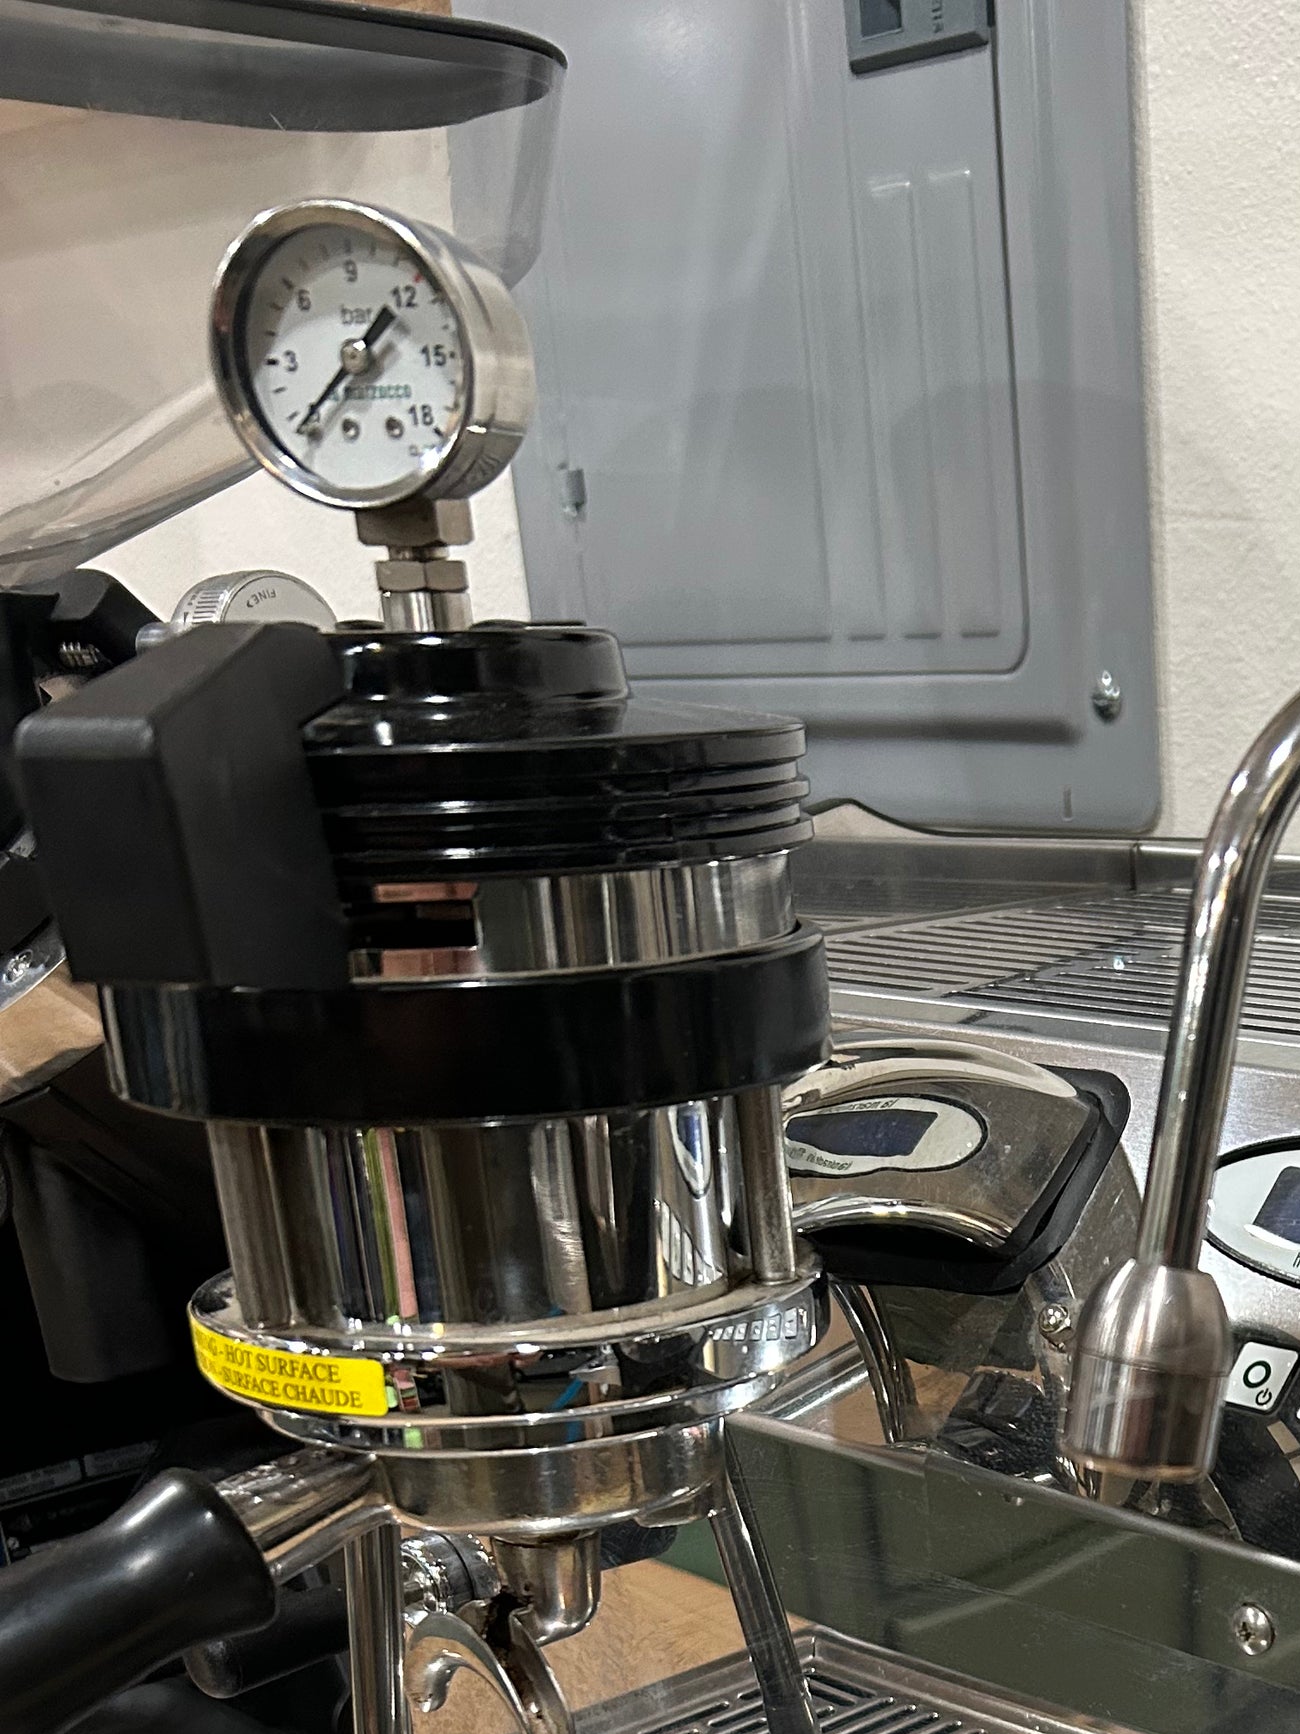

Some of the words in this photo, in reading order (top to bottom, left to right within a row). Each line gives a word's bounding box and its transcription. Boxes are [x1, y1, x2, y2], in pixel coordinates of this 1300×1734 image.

[344, 260, 358, 282] 9
[296, 290, 311, 312] 6
[390, 285, 418, 309] 12
[340, 303, 373, 325] bar
[284, 350, 298, 372] 3
[419, 344, 447, 367] 15
[407, 404, 435, 426] 18
[254, 588, 277, 604] FINE
[225, 1344, 252, 1369] HOT
[256, 1352, 342, 1384] SURFACE
[282, 1382, 364, 1409] CHAUDE
